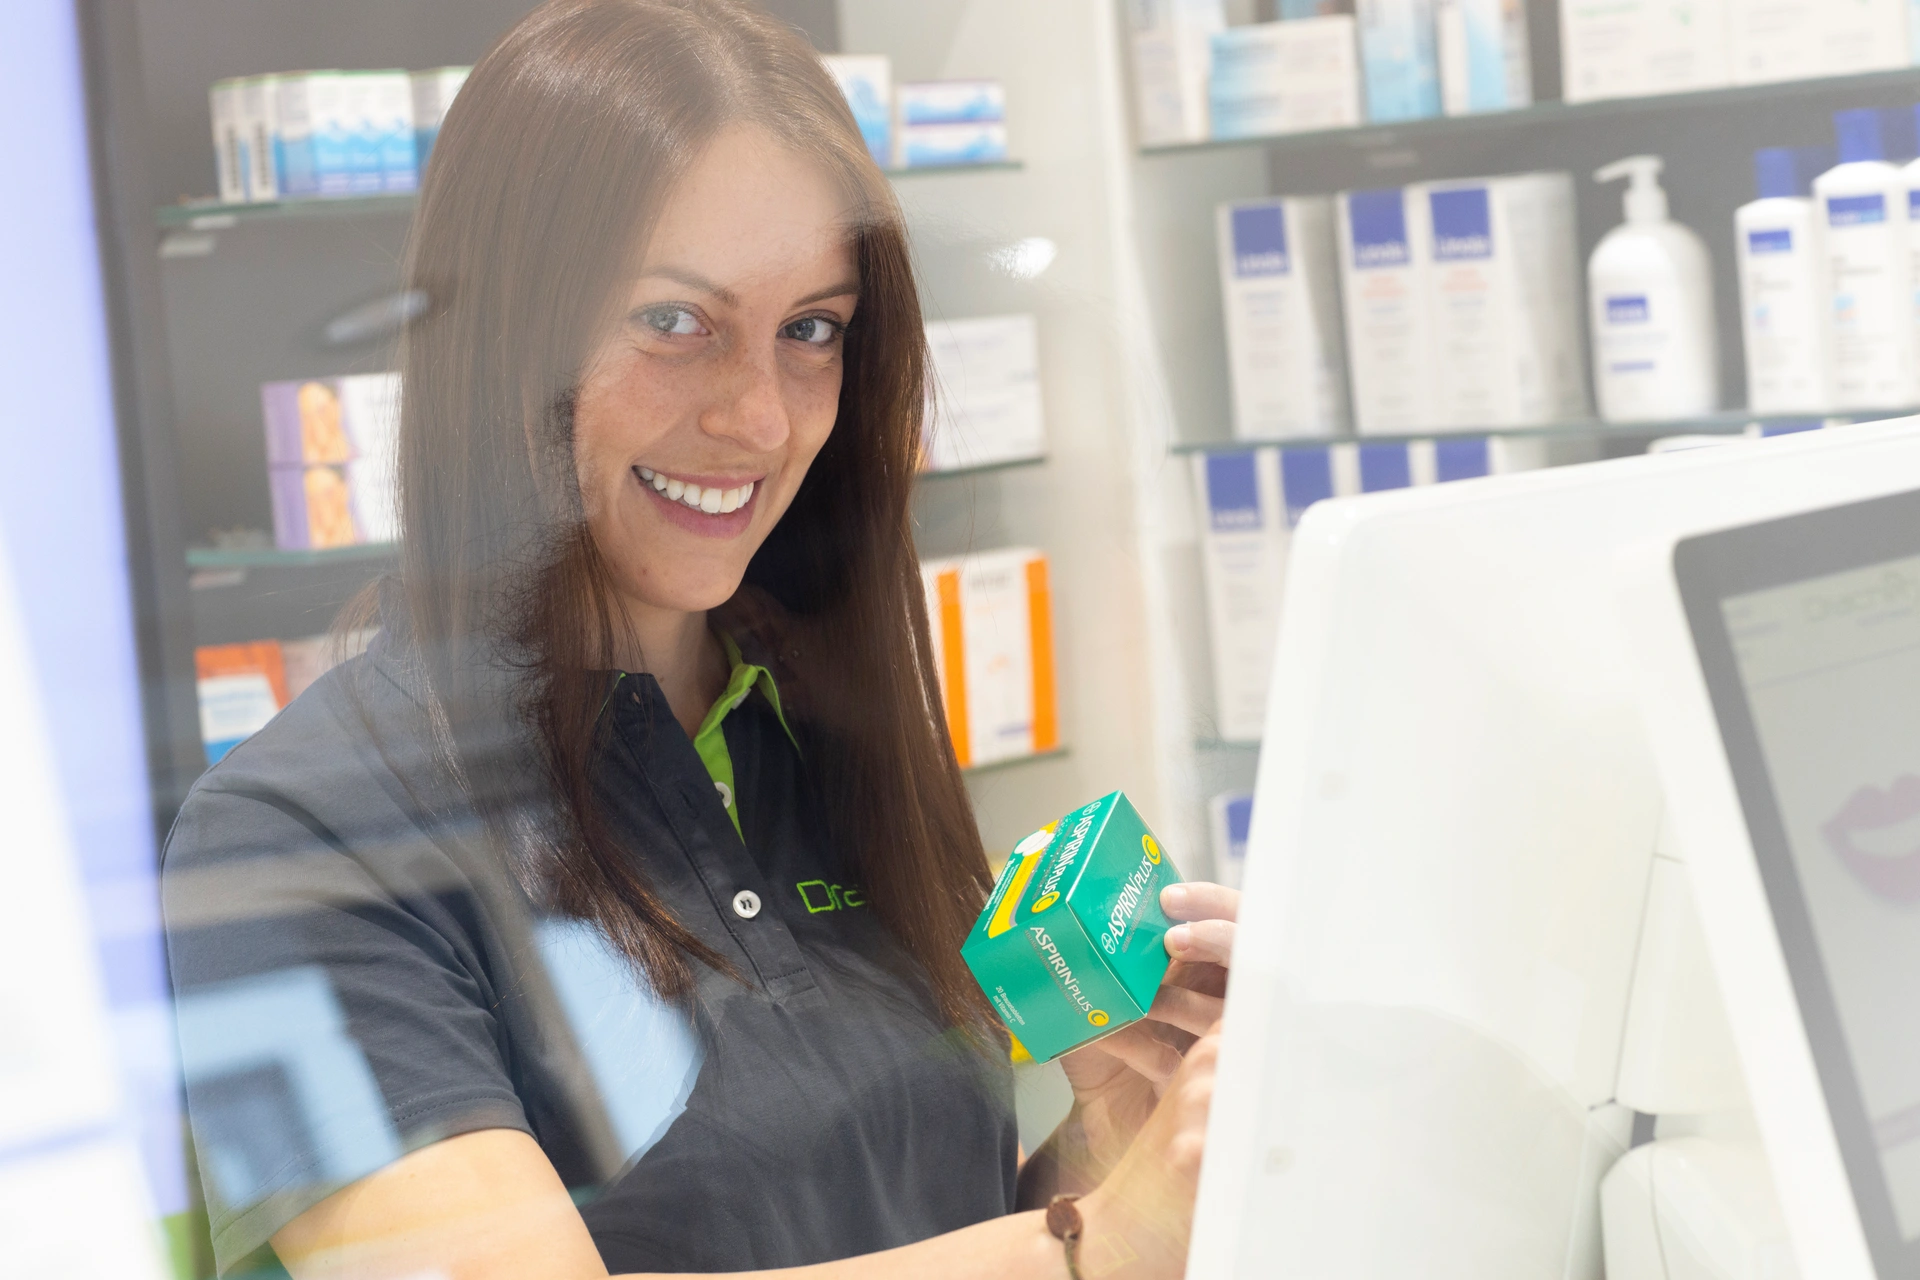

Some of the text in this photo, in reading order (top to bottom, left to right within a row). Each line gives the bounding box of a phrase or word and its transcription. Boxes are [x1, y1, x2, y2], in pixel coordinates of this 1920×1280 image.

[1107, 876, 1142, 945] ASPIRIN
[1133, 855, 1153, 891] PLUS
[996, 985, 1004, 993] 20
[1030, 926, 1077, 986] ASPIRIN
[1067, 984, 1093, 1012] PLUS
